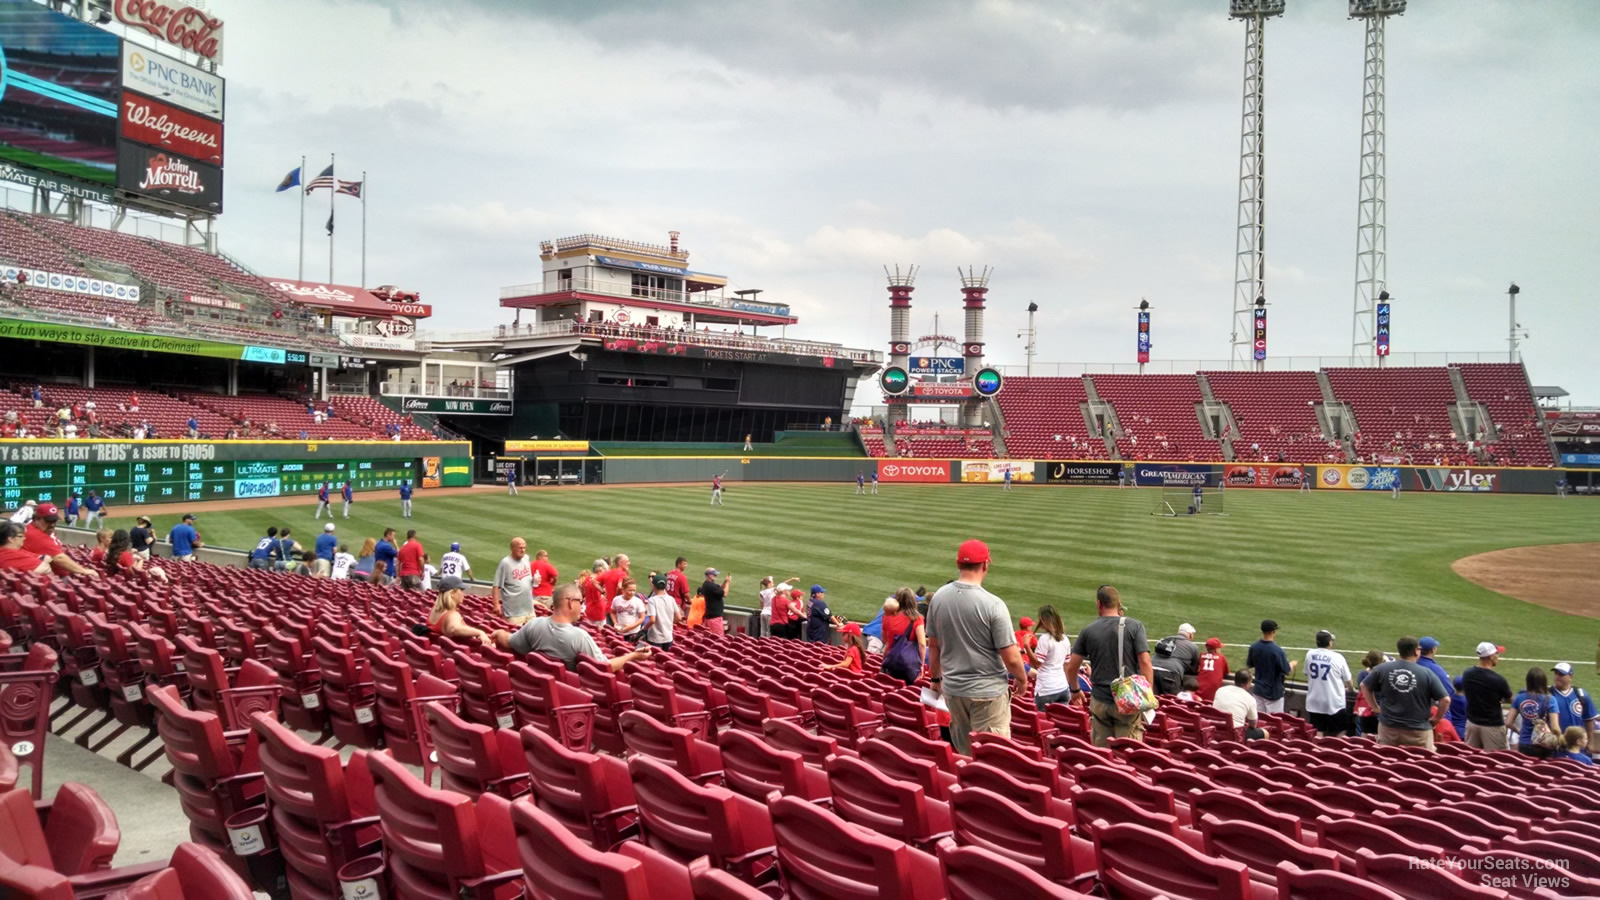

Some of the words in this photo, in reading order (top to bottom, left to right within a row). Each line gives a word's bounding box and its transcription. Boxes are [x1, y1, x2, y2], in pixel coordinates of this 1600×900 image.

[114, 0, 224, 58] Coca-Cola
[147, 60, 178, 84] PNC
[180, 72, 217, 99] BANK
[125, 101, 218, 148] Walgreens
[164, 157, 189, 173] John
[139, 166, 204, 192] Morrell
[38, 179, 57, 190] AIR
[61, 184, 111, 203] SHUTTLE
[270, 281, 355, 299] Reds
[732, 301, 774, 313] Cincinnati
[775, 304, 790, 316] Bell
[0, 322, 13, 334] or
[16, 324, 36, 337] fun
[39, 329, 68, 342] ways
[71, 331, 82, 341] to
[85, 334, 107, 345] stay
[109, 335, 138, 347] active
[140, 337, 150, 348] in
[152, 338, 201, 352] Cincinnati!
[704, 349, 733, 360] TICKETS
[735, 351, 756, 361] START
[757, 353, 767, 362] AT
[931, 358, 955, 368] PNC
[445, 401, 458, 411] NOW
[460, 401, 474, 411] OPEN
[11, 448, 19, 460] &
[22, 446, 64, 460] SERVICE
[67, 446, 90, 459] TEXT
[133, 448, 139, 459] &
[143, 446, 167, 459] ISSUE
[169, 446, 180, 459] TO
[182, 444, 215, 460] 69050
[5, 466, 17, 475] PIT
[74, 465, 85, 473] PHI
[135, 464, 146, 472] ATL
[238, 466, 278, 474] ULTIMATE
[901, 466, 945, 476] TOYOTA
[1067, 467, 1114, 475] HORSESHOE
[5, 478, 18, 486] STL
[135, 474, 149, 482] NYM
[1415, 468, 1497, 490] Wyler
[239, 482, 258, 495] Chips
[258, 480, 277, 494] Ahoy!
[5, 490, 20, 498] HOU
[5, 501, 18, 509] TEX
[336, 560, 346, 569] 12
[443, 563, 455, 574] 23
[512, 567, 530, 580] Reds
[1312, 654, 1332, 663] WELCH
[1203, 659, 1215, 671] 11
[1309, 662, 1331, 681] 97
[18, 744, 28, 752] R
